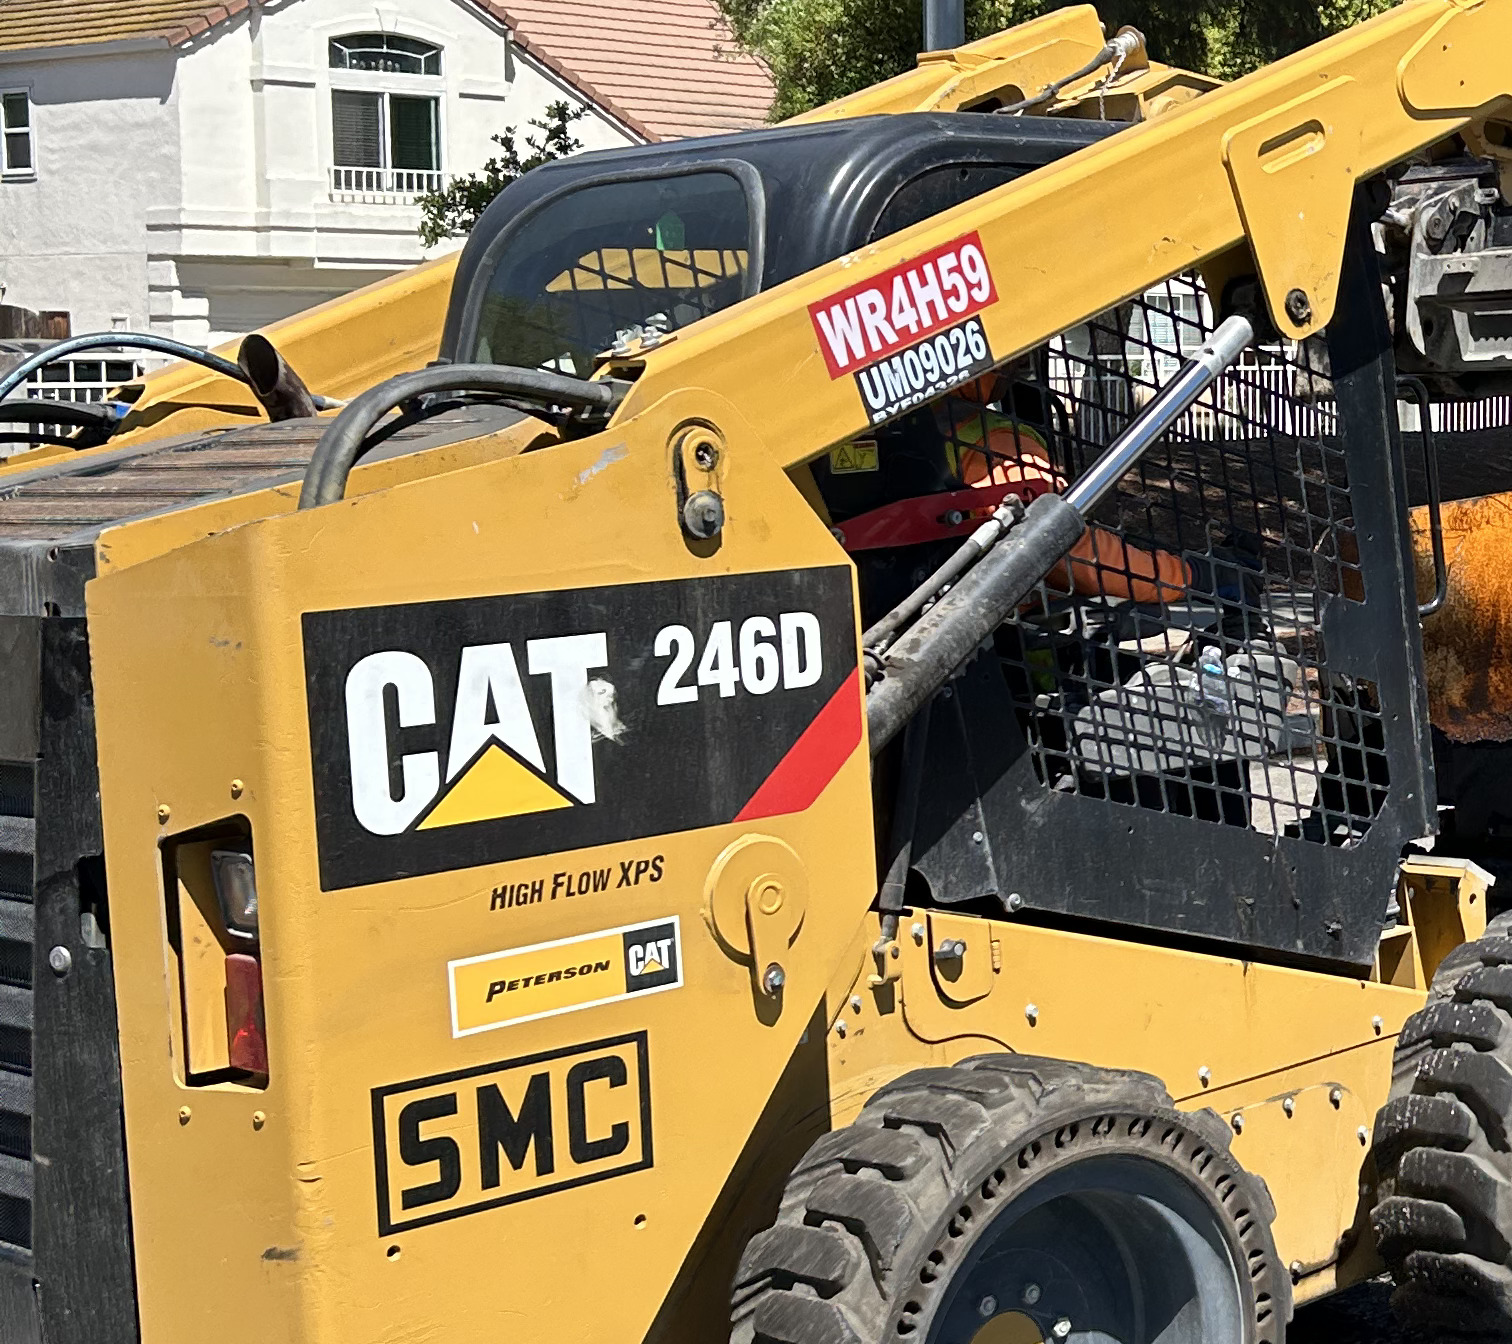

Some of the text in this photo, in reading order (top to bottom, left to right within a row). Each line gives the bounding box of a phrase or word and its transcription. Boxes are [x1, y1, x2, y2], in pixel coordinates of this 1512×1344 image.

[816, 244, 990, 368] WR4H59
[859, 320, 987, 410] UM09026
[345, 611, 823, 836] CAT 246D
[490, 854, 665, 911] HIGH FLOW XPS
[485, 937, 672, 1003] PETERSON CAT
[398, 1054, 630, 1211] SMC
